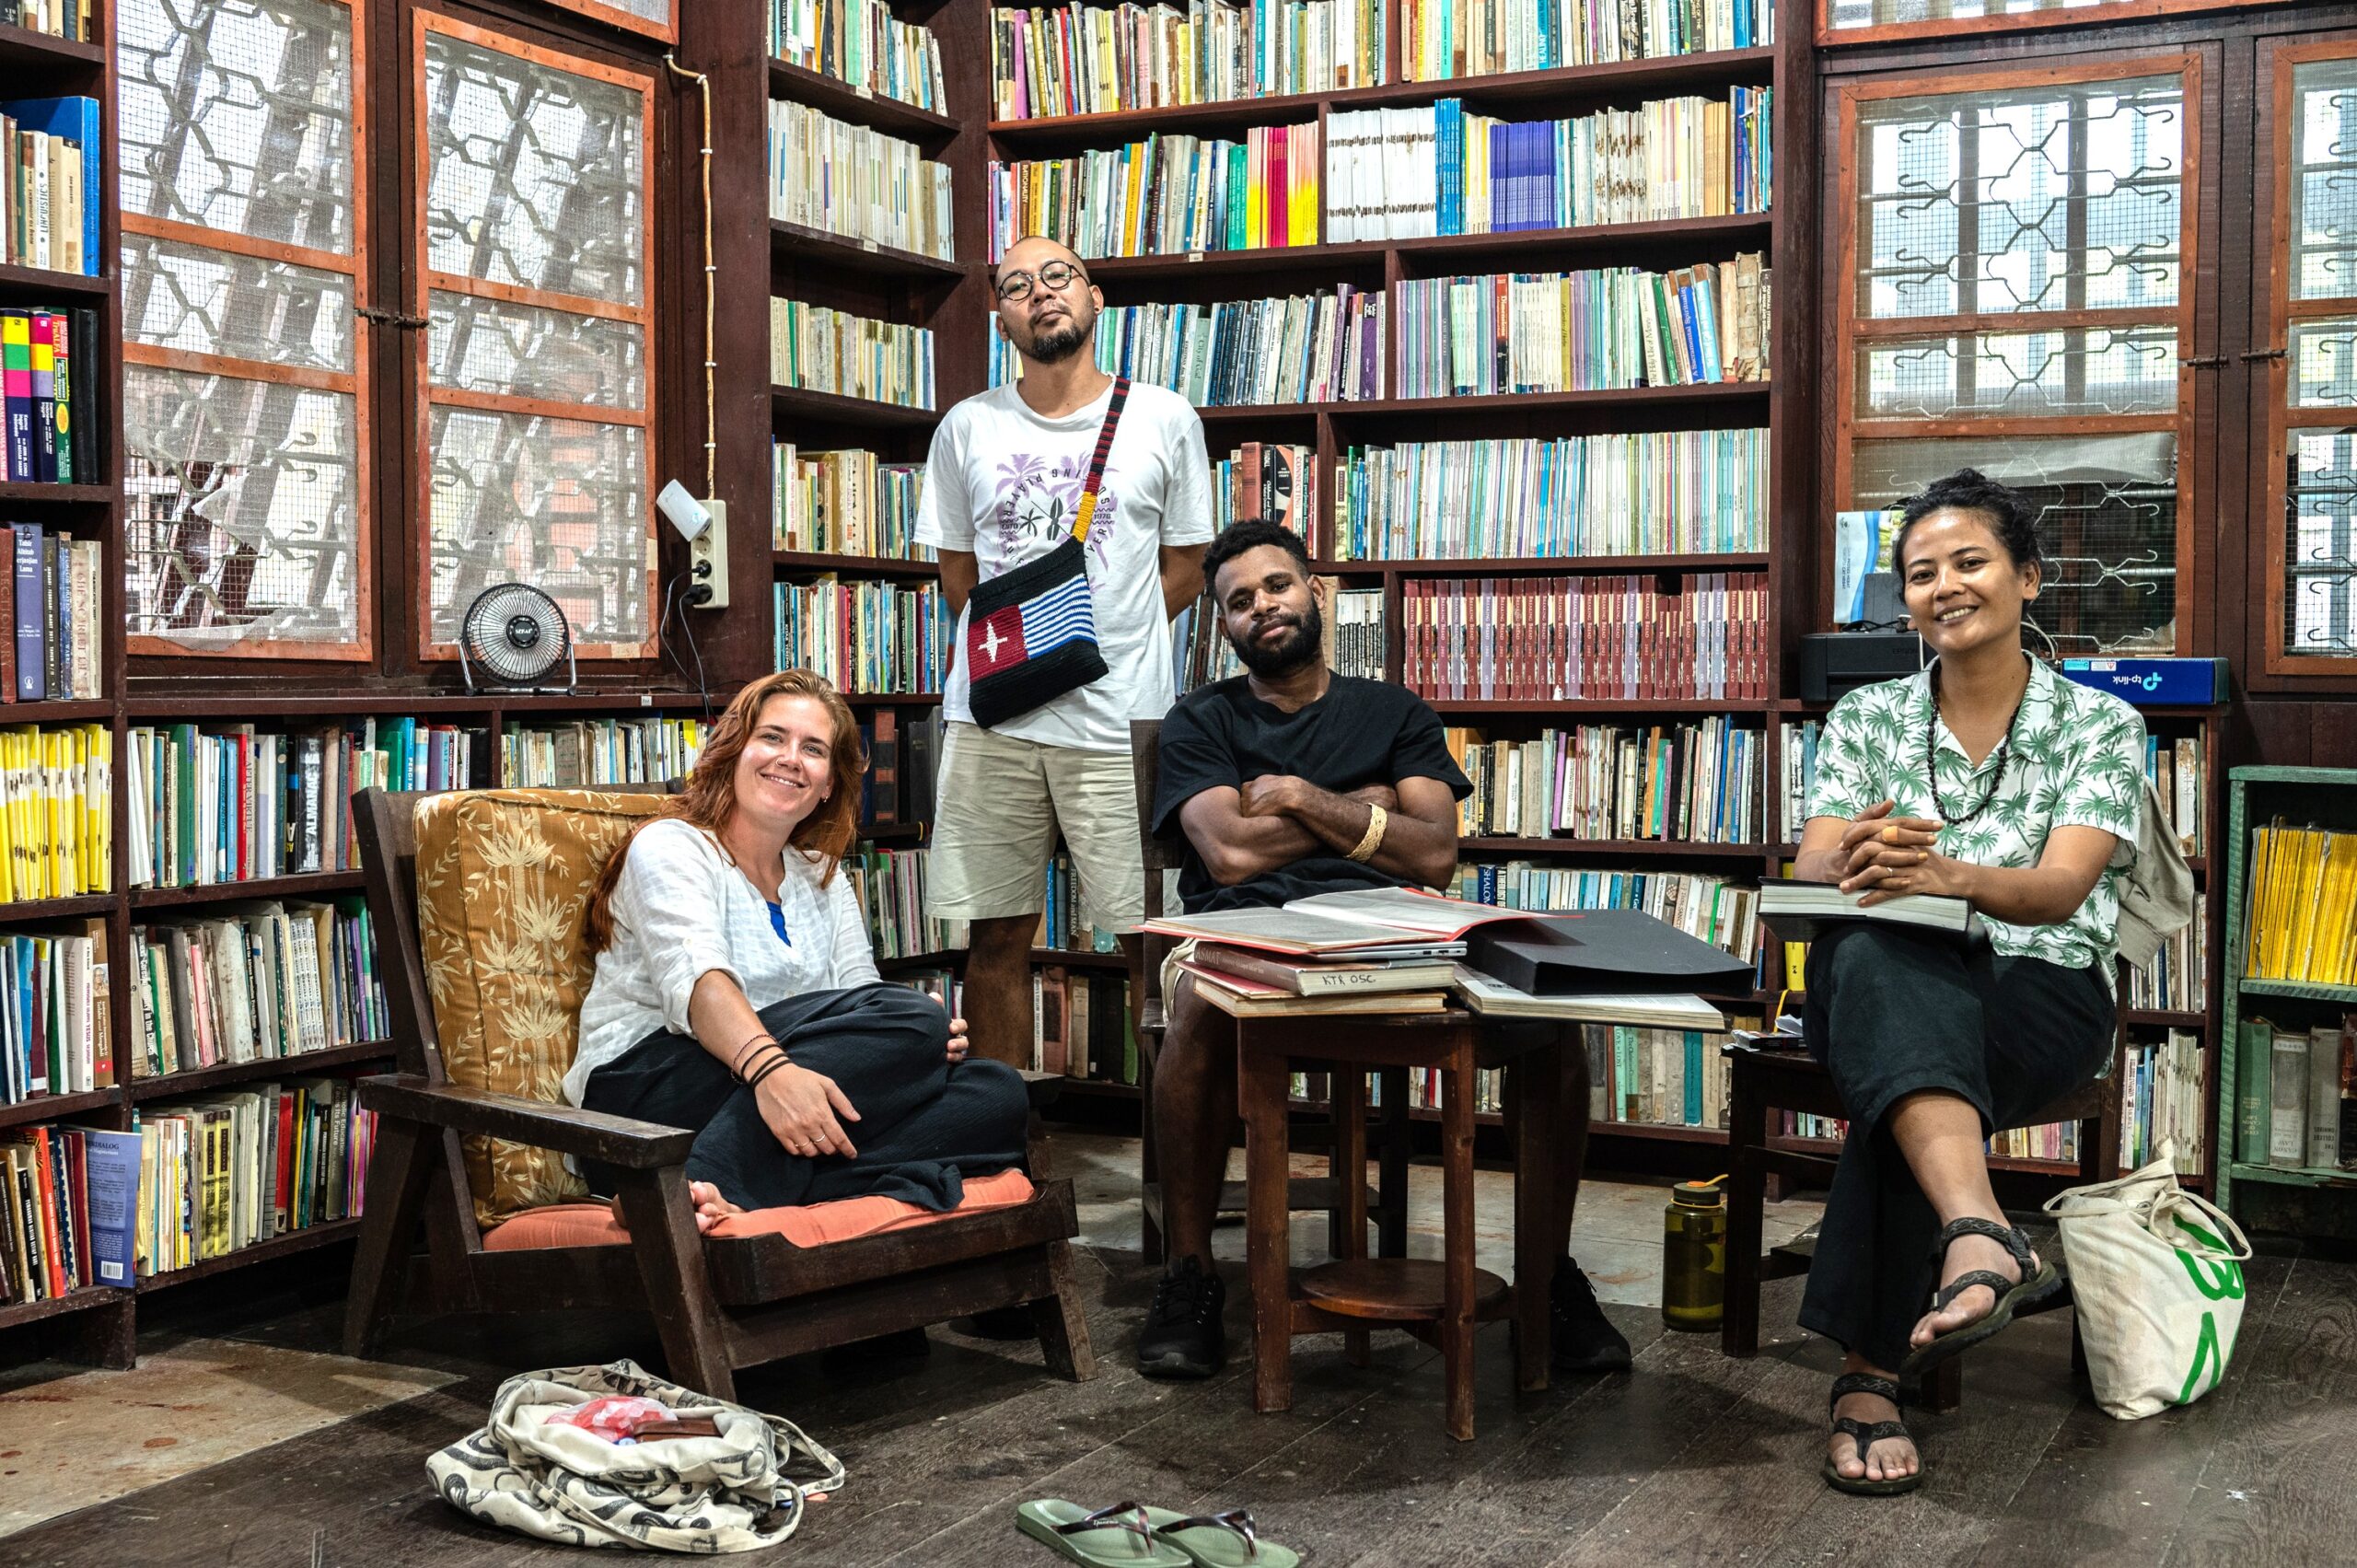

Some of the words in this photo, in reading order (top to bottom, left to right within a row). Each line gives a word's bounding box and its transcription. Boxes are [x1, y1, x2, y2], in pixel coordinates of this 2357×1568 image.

[40, 182, 49, 234] LINGUISTICS
[1679, 286, 1691, 324] Spirituality
[1196, 340, 1204, 354] City
[1686, 326, 1696, 369] Sacramental
[1194, 365, 1202, 379] God
[1649, 359, 1657, 372] Holy
[305, 772, 318, 836] ALMANAC
[1482, 869, 1492, 904] SHALOM
[1497, 875, 1506, 900] THEOLOGY
[1195, 947, 1222, 968] ASMAT
[1322, 974, 1345, 986] KTR
[146, 1032, 155, 1055] Church
[339, 1086, 348, 1117] Catholic
[339, 1118, 347, 1156] Education
